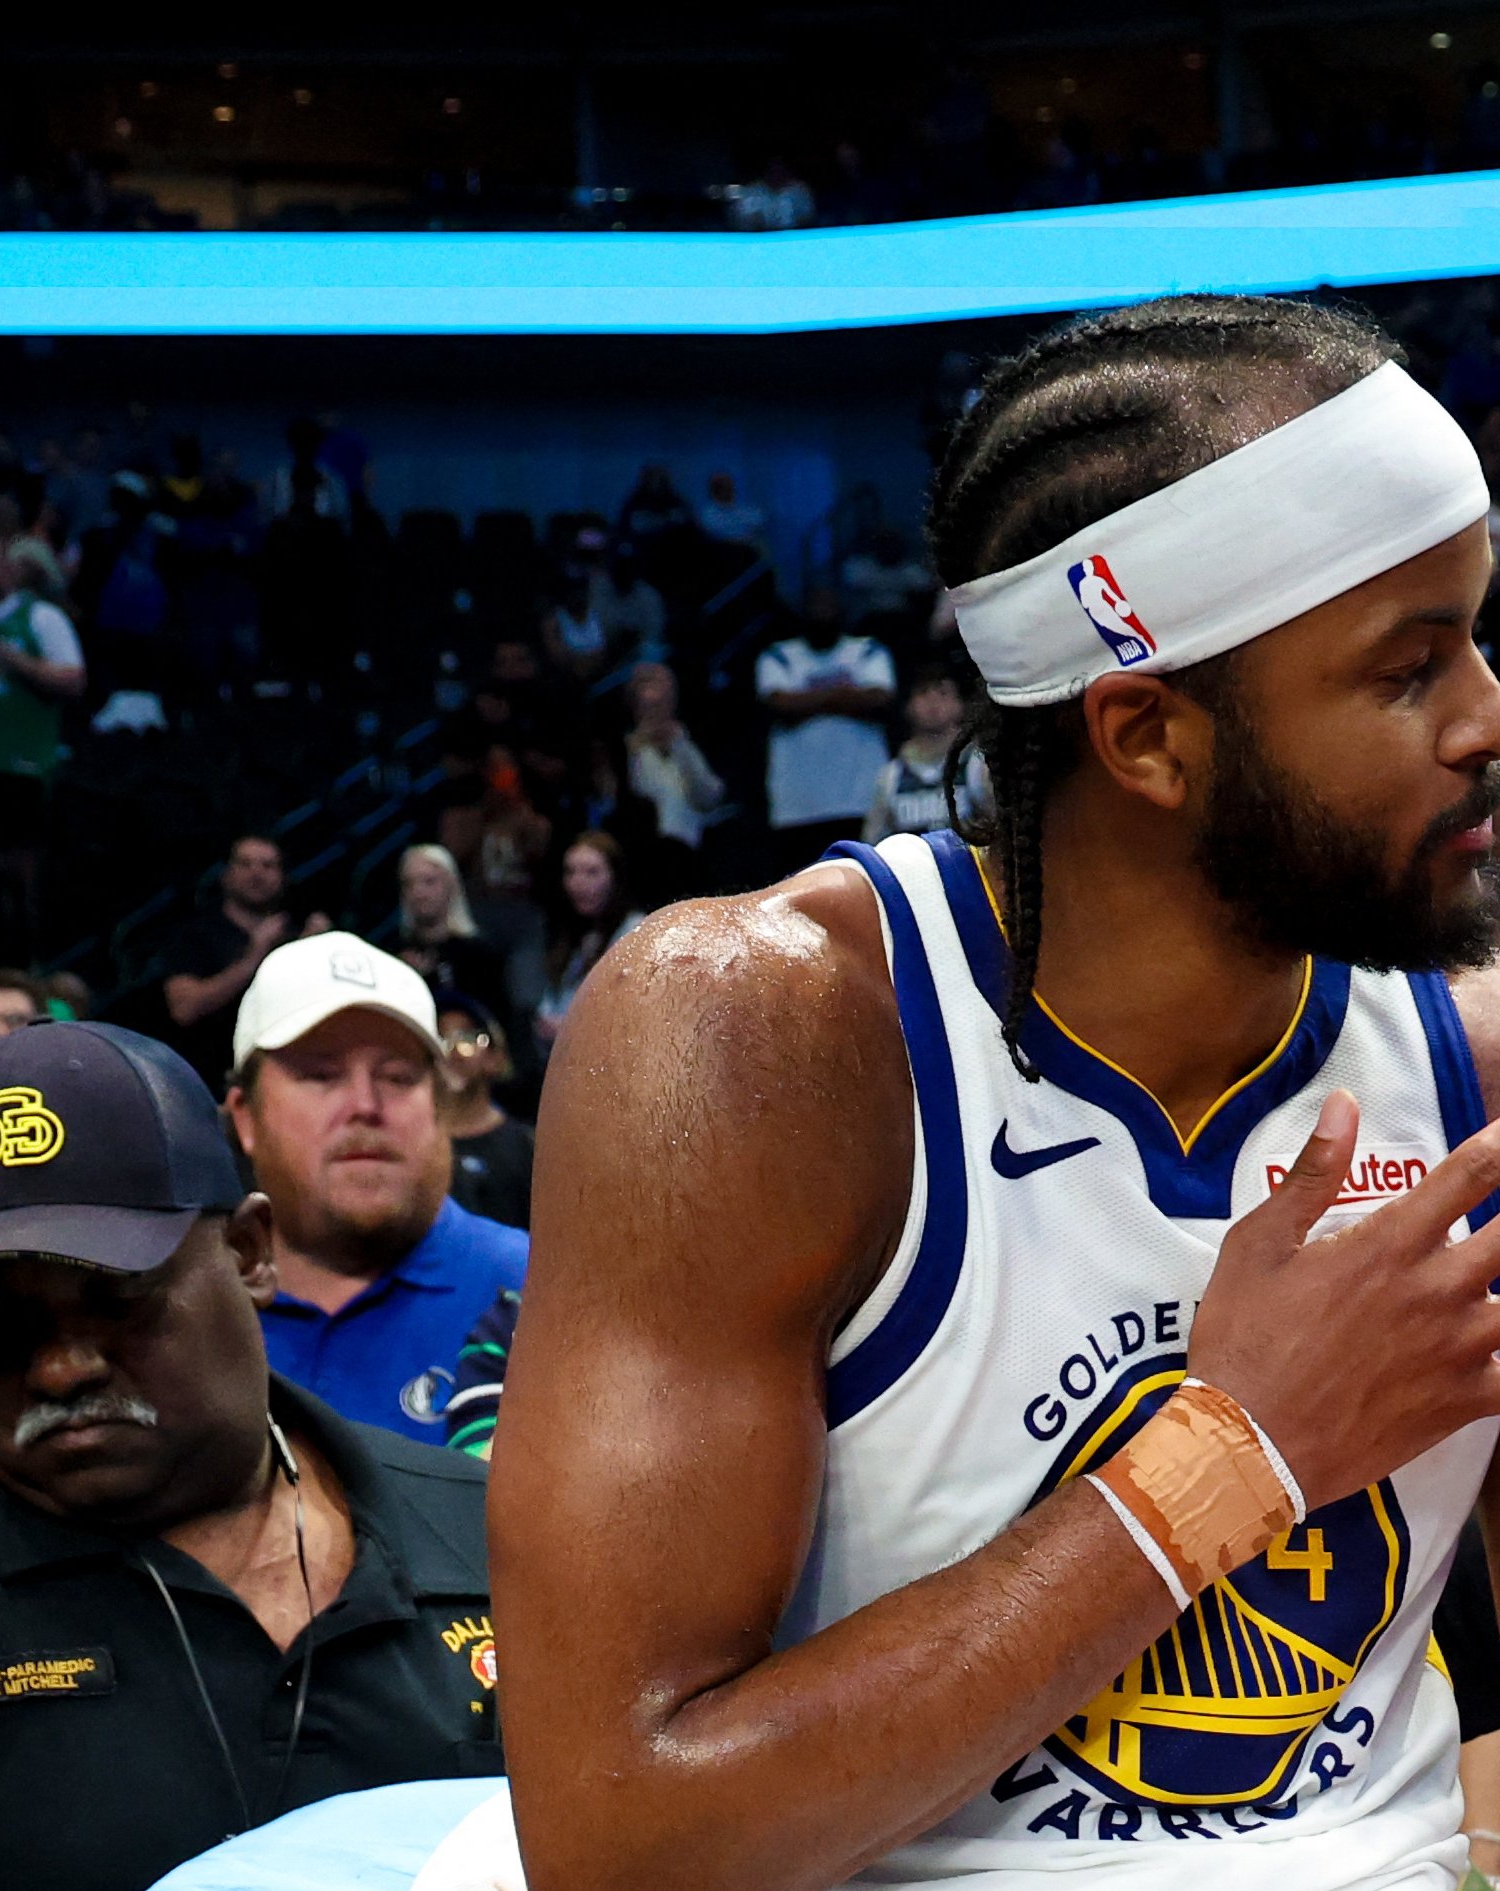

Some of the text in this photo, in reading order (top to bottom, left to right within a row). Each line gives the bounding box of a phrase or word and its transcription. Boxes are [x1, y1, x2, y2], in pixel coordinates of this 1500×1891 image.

[1116, 640, 1143, 662] NBA
[1266, 1153, 1428, 1198] Ruten
[1024, 1299, 1204, 1442] GOLDE
[441, 1615, 494, 1653] DALL
[4, 1674, 79, 1695] MITCHELL
